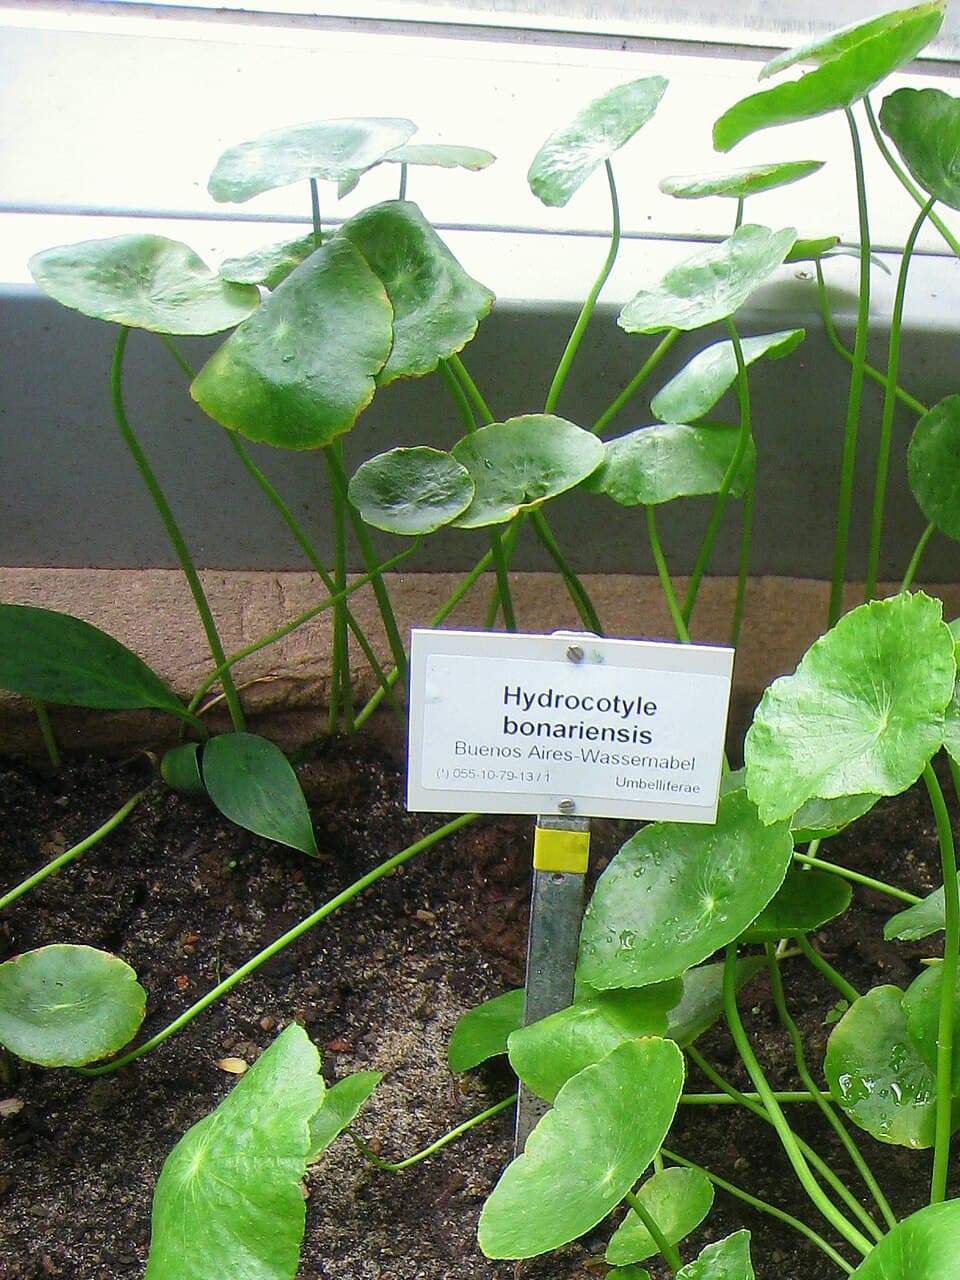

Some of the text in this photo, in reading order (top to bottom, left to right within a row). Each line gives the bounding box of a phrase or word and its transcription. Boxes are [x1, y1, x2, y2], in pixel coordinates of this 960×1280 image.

[503, 686, 658, 719] Hydrocotyle
[503, 716, 653, 745] bonariensis
[454, 741, 696, 772] Buenos Aires-Wassernabel
[615, 776, 701, 795] Umbelliferae
